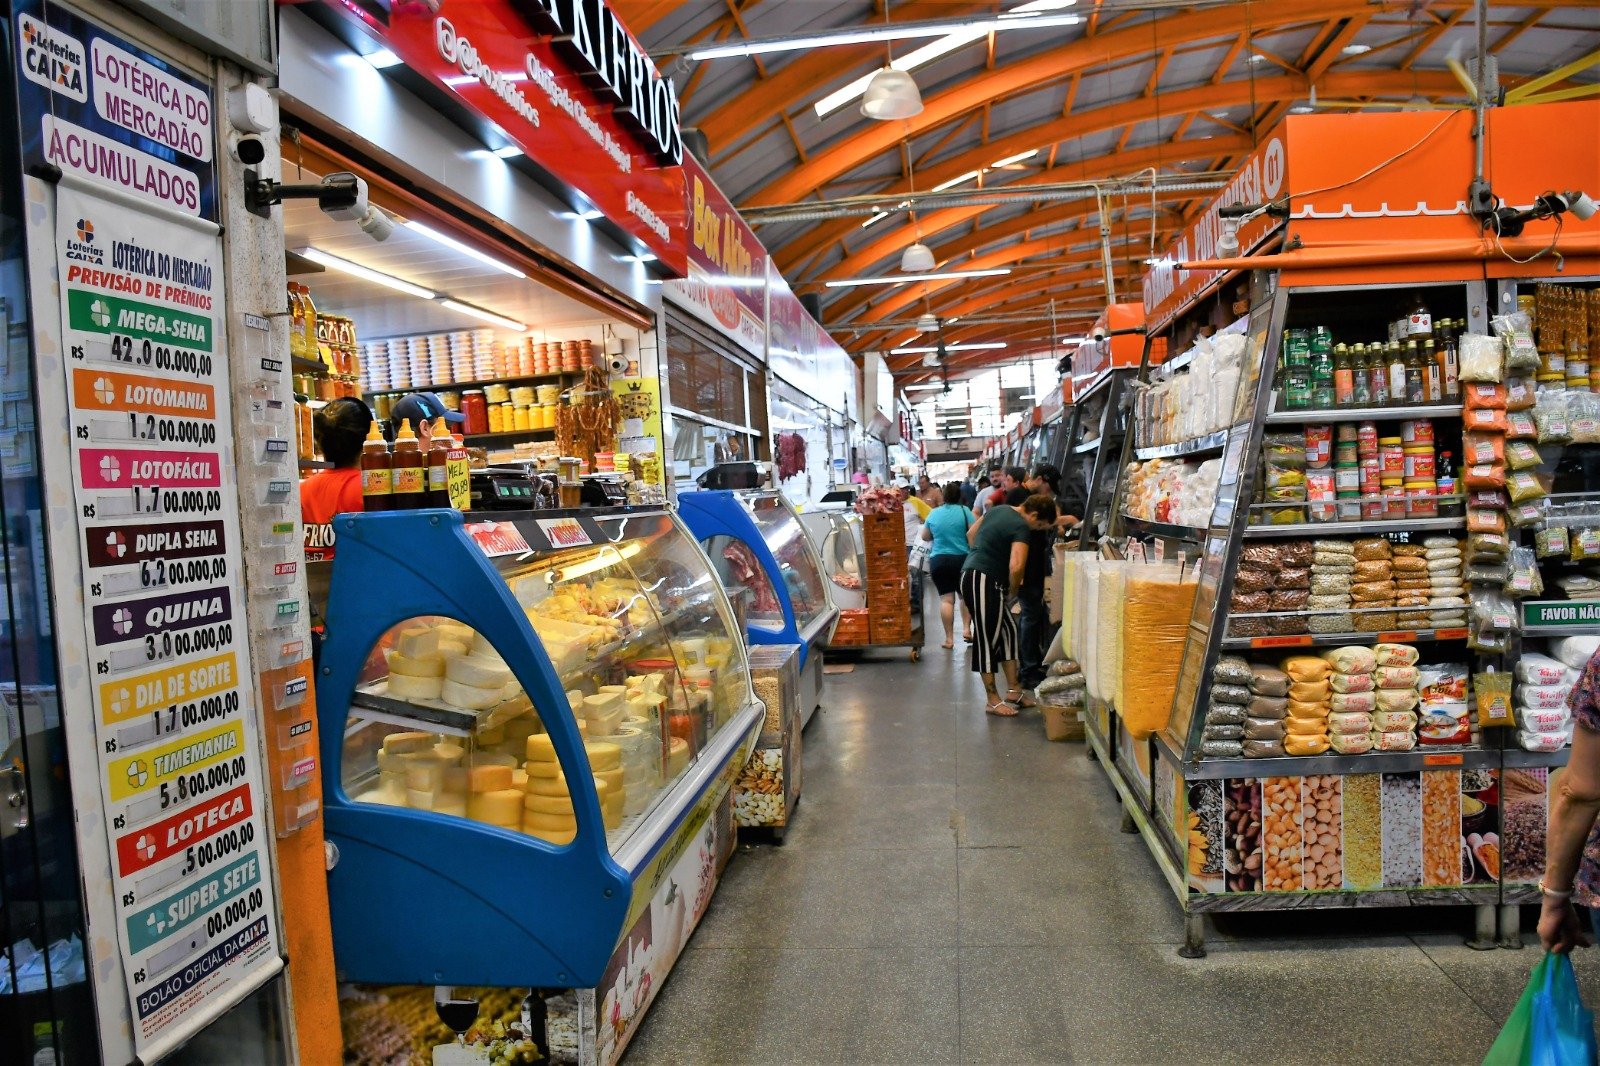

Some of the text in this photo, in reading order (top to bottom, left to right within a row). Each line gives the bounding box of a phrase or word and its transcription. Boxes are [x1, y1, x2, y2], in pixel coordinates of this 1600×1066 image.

[37, 31, 81, 65] Loterias
[26, 49, 83, 94] CAIXA
[94, 48, 209, 126] LOTÉRICA DO
[105, 91, 203, 158] MERCADÃO
[49, 128, 197, 210] ACUMULADOS
[66, 251, 104, 266] CAIXA
[67, 240, 104, 257] Loterias
[112, 238, 212, 291] LOTÉRICA DO MERCADÃO
[67, 265, 212, 311] PREVISÃO DE PRÊMIOS
[117, 309, 206, 343] MEGA-SENA
[71, 345, 84, 361] R$
[125, 384, 208, 411] LOTOMANIA
[76, 425, 89, 440] R$
[131, 457, 213, 480] LOTOFÁCIL
[447, 462, 464, 479] MEL
[83, 503, 96, 519] R$
[135, 528, 218, 553] DUPLA SENA
[91, 582, 102, 597] R$
[145, 596, 224, 629] QUINA
[1541, 607, 1577, 620] FAVOR
[97, 659, 109, 675] R$
[135, 661, 231, 709] DIA DE SORTE
[105, 738, 117, 754] R$
[154, 730, 237, 778] TIMEMANIA
[113, 814, 125, 830] R$
[166, 796, 244, 848] LOTECA
[122, 891, 135, 907] R$
[168, 858, 256, 928] SUPER SETE
[133, 968, 146, 984] R$
[141, 977, 182, 1013] BOLÃO
[184, 953, 223, 984] OFICIAL
[224, 941, 239, 957] DA
[238, 920, 267, 947] CAIXA
